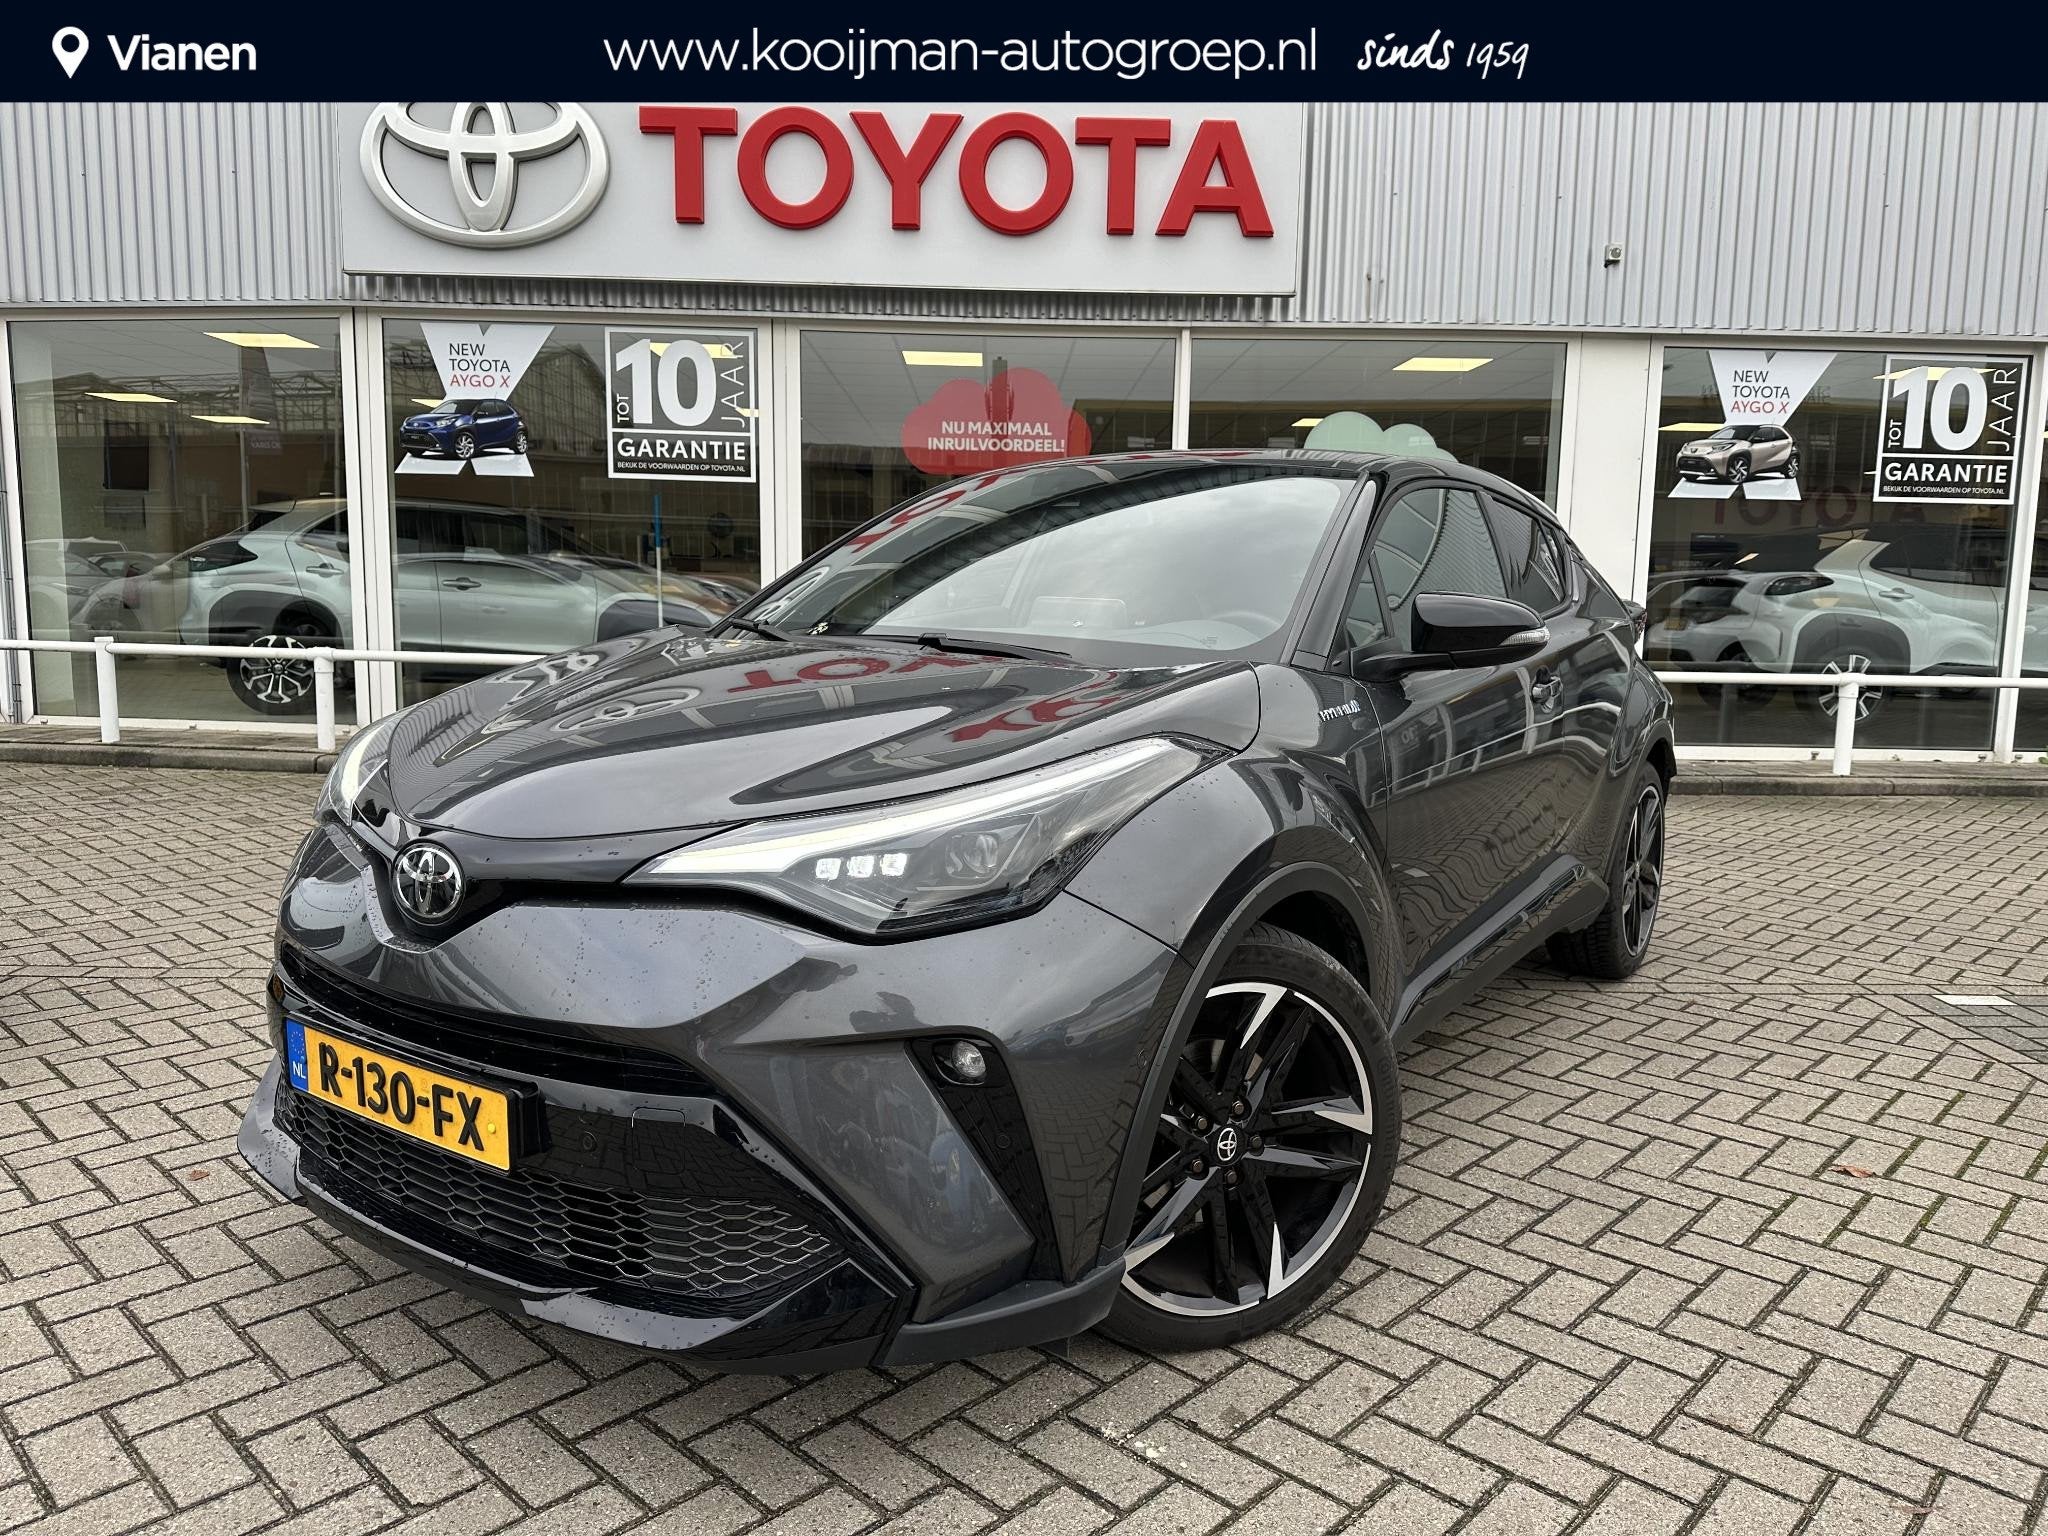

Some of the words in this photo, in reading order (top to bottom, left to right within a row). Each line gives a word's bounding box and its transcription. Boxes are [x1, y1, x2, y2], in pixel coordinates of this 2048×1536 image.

[638, 105, 1275, 238] TOYOTA
[449, 342, 486, 357] NEW
[449, 358, 511, 373] TOYOTA
[450, 374, 495, 388] AYGO
[499, 375, 511, 388] X
[615, 338, 717, 427] 10
[720, 341, 745, 429] JAAR
[1733, 370, 1769, 383] NEW
[1732, 385, 1791, 399] TOYOTA
[616, 392, 630, 424] TOT
[1730, 400, 1775, 414] AYGO
[1778, 401, 1790, 414] X
[1892, 365, 1988, 451] 10
[1987, 367, 2018, 452] JAAR
[941, 421, 965, 435] NU
[968, 421, 1053, 436] MAXIMAAL
[1887, 419, 1903, 449] TOT
[617, 437, 746, 461] GARANTIE
[927, 437, 1066, 453] INRUILVOORDEEL!
[648, 462, 700, 471] VOORWAARDEN
[711, 464, 746, 473] TOYOTA.NL
[1884, 462, 2008, 484] GARANTIE
[1912, 486, 1961, 494] VOORWAARDEN
[1971, 487, 2005, 495] TOYOTA.NL
[292, 1062, 307, 1080] NL
[318, 1041, 485, 1152] R-130-FX
